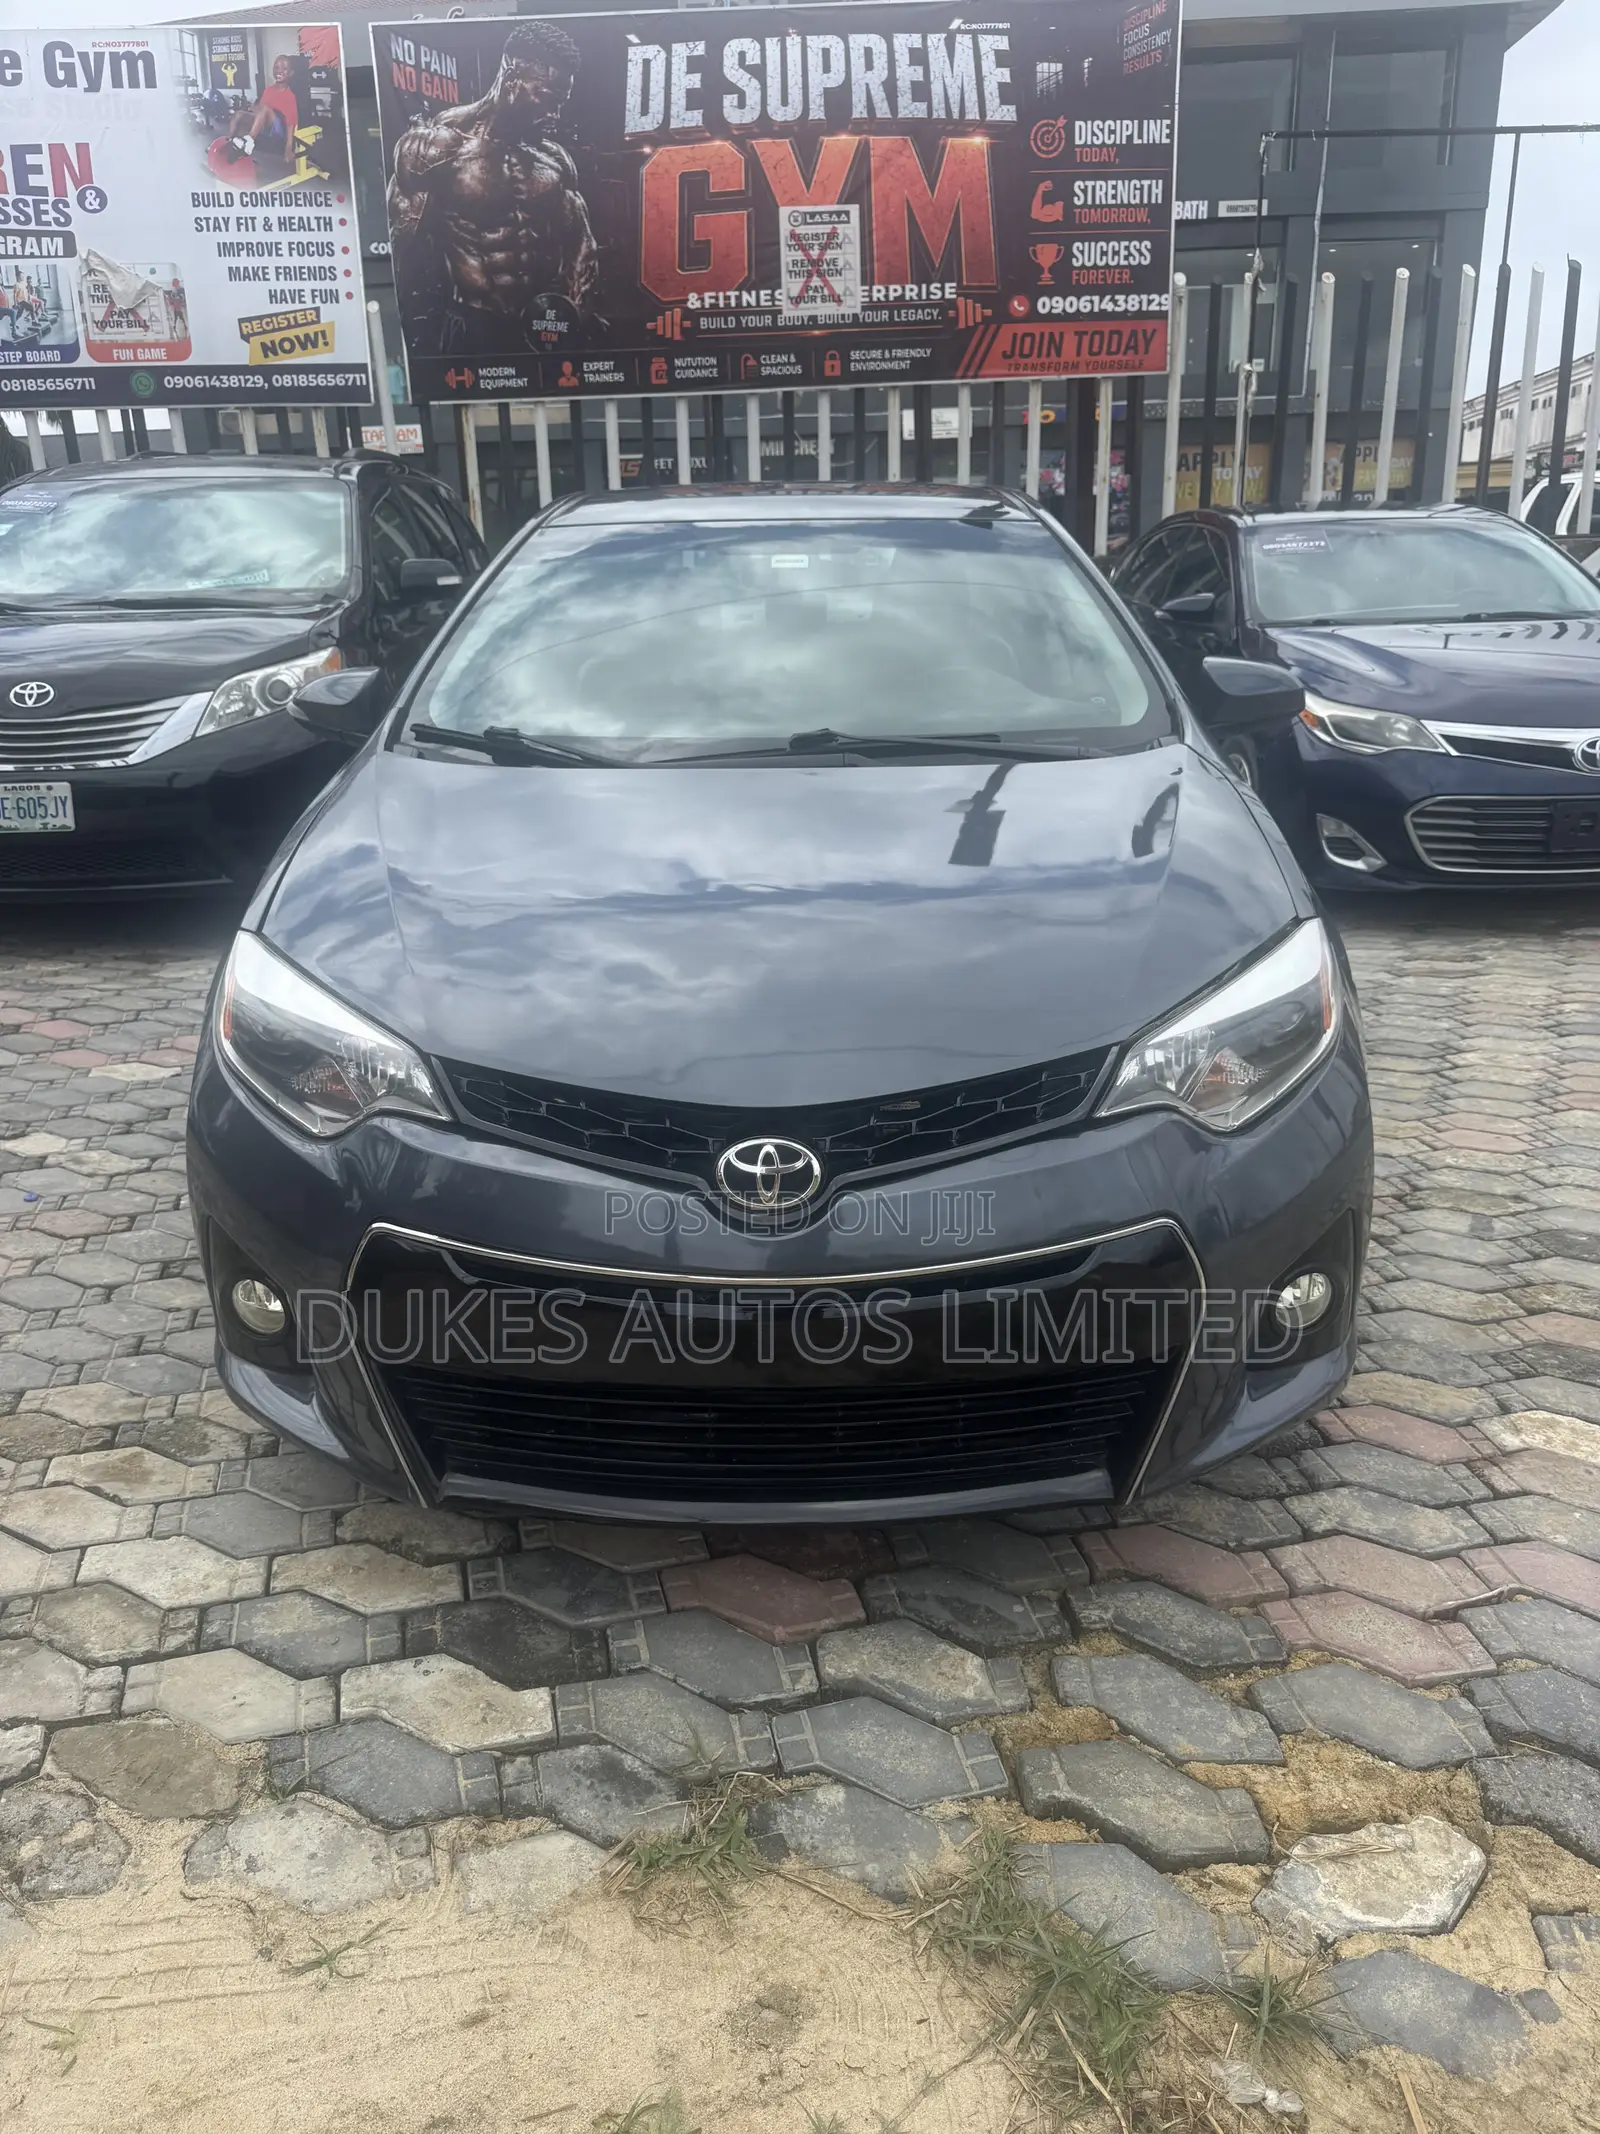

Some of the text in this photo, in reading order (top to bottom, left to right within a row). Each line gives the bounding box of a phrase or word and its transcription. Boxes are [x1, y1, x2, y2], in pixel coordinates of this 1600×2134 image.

[1123, 23, 1150, 46] FOCUS
[1123, 29, 1172, 60] CONSISTENCY
[390, 32, 458, 81] NO PAIN
[1123, 51, 1162, 75] RESULTS
[43, 41, 157, 92] Gym
[392, 62, 460, 105] NO GAIN
[1075, 119, 1171, 145] DISCIPLINE
[1075, 147, 1120, 164] TODAY,
[0, 143, 94, 198] EN
[191, 191, 333, 208] BUILD CONFIDENCE
[1073, 180, 1163, 205] STRENGTH
[806, 213, 849, 223] LASAA
[1074, 207, 1151, 224] TOMORROW,
[1174, 200, 1209, 220] BATH
[194, 216, 334, 232] STAY FIT & HEALTH
[641, 137, 998, 302] GYM
[789, 231, 840, 242] REGISTER
[217, 241, 336, 258] IMPROVE FOCUS
[787, 242, 843, 253] YOUR SIGN
[1072, 240, 1152, 267] SUCCESS
[792, 258, 839, 268] REMOVE
[228, 265, 337, 282] MAKE FRIENDS
[788, 268, 843, 279] THIS SIGN
[1072, 268, 1134, 285] FOREVER.
[268, 288, 340, 304] HAVE FUN
[806, 285, 827, 294] PAY
[788, 294, 844, 305] YOUR BILL
[1037, 294, 1170, 314] 09061438129
[110, 310, 132, 319] PAY
[545, 309, 557, 320] DE
[700, 316, 735, 329] BUILD
[740, 315, 772, 328] YOUR
[817, 312, 851, 325] BUILD
[856, 310, 889, 323] YOUR
[894, 308, 942, 322] LEGACY.
[94, 320, 150, 329] YOUR BILL
[240, 310, 318, 336] REGISTER
[532, 320, 569, 333] SUPREME
[260, 329, 329, 359] NOW!
[541, 332, 559, 342] GYM
[1002, 328, 1157, 360] JOIN TODAY
[25, 350, 61, 362] BOARD
[113, 348, 167, 361] FUN GAME
[760, 354, 796, 365] CLEAN &
[850, 348, 932, 360] SECURE & FRIENDLY
[478, 367, 516, 377] MODERN
[583, 361, 615, 372] EXPERT
[674, 368, 719, 379] GUIDANCE
[760, 365, 803, 376] SPACIOUS
[850, 360, 911, 372] ENVIRONMENT
[1007, 358, 1145, 373] TRANSFORM YOURSELF
[1, 373, 367, 392] 08185656711 09061438129, 08185656711
[480, 378, 528, 390] EQUIPMENT
[584, 372, 625, 383] TRAINERS
[1212, 466, 1263, 480] TOAY
[0, 795, 68, 820] E-605JY
